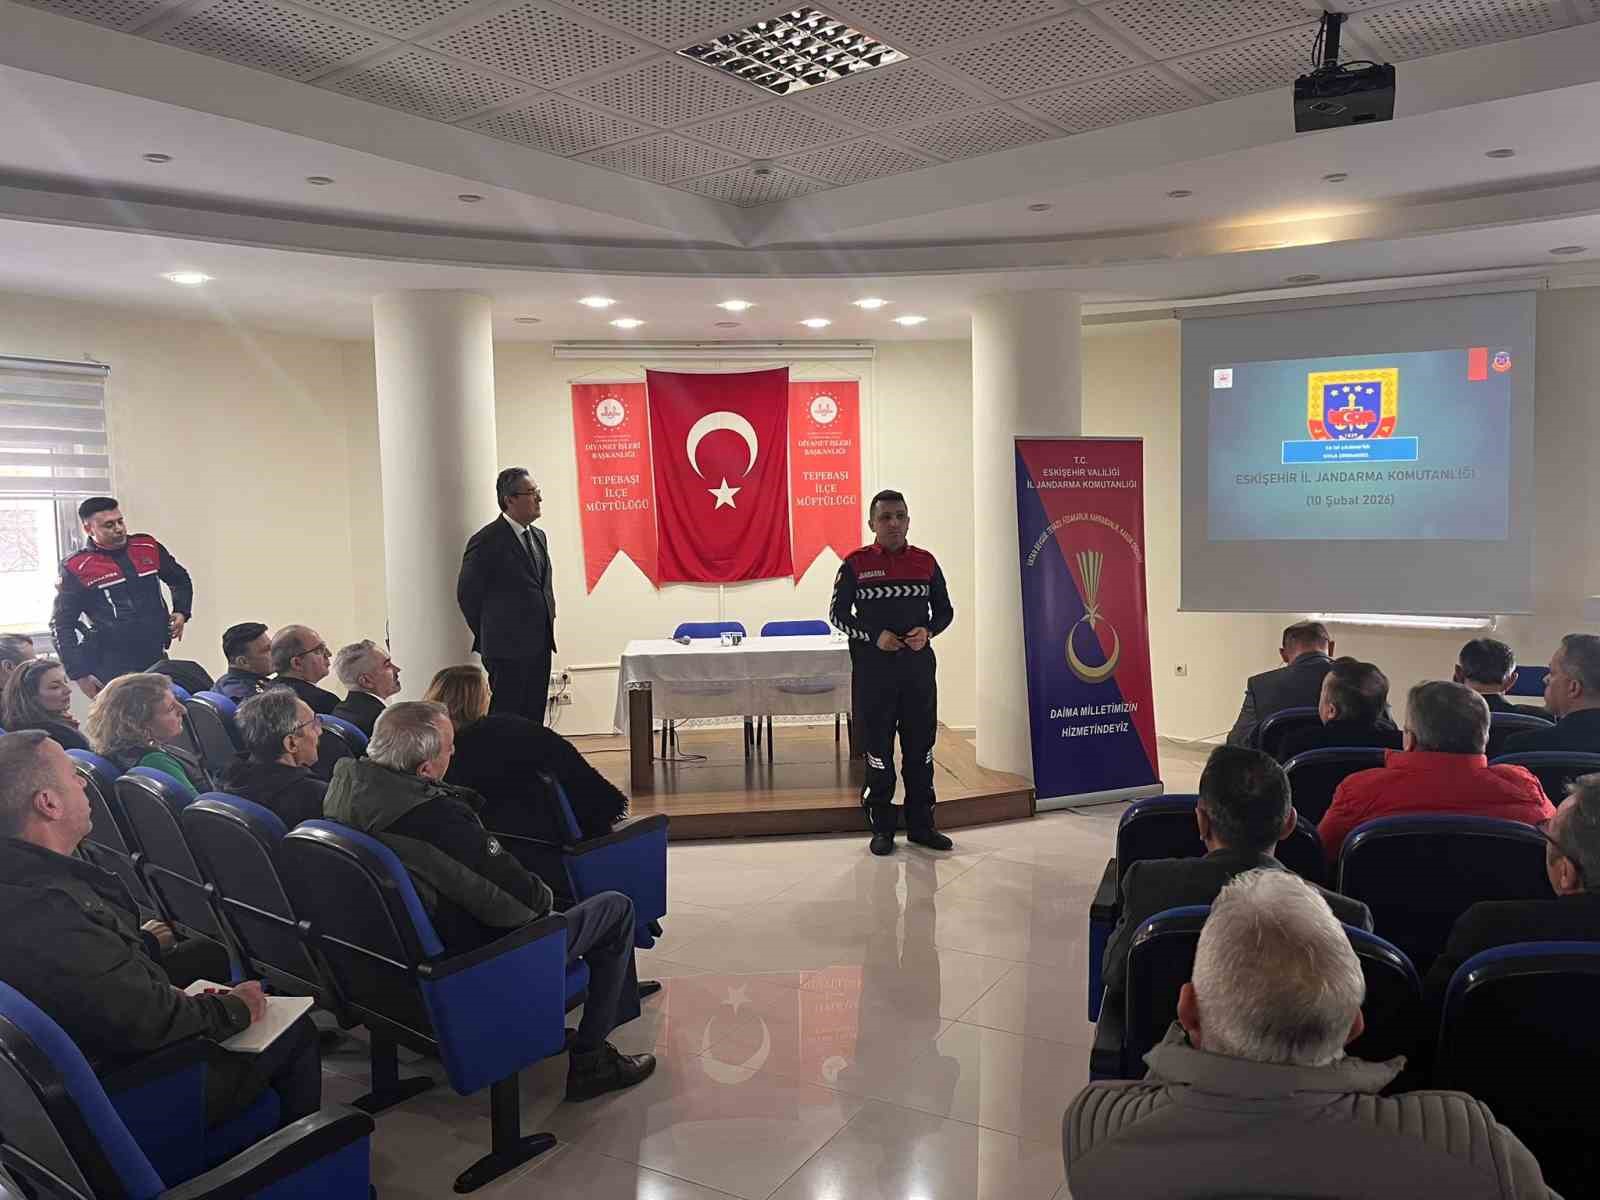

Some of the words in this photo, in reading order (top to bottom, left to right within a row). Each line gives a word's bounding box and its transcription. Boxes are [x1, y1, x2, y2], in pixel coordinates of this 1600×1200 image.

[802, 471, 849, 482] TEPEBAŞI
[1042, 466, 1085, 478] ESKİŞEHİR
[1235, 471, 1297, 486] ESKİŞEHİR
[1301, 470, 1312, 483] İL
[1315, 470, 1384, 483] JANDARMA
[1388, 465, 1475, 481] KOMUTANLIĞI
[592, 474, 640, 486] TEPEBAŞI
[1026, 478, 1035, 489] İL
[1036, 480, 1081, 489] JANDARMA
[1082, 479, 1137, 489] KOMUTANLIĞI
[605, 487, 629, 498] İLÇE
[815, 482, 838, 495] İLÇE
[585, 498, 649, 512] MÜFTÜLÜĞÜ
[1306, 495, 1321, 507] (10
[1326, 494, 1359, 508] Şubat
[1362, 493, 1394, 507] 2026)
[1050, 706, 1079, 719] DAİMA
[1080, 702, 1138, 717] MİLLETİMİZİN
[1061, 720, 1129, 738] HİZMETİNDEYİZ
